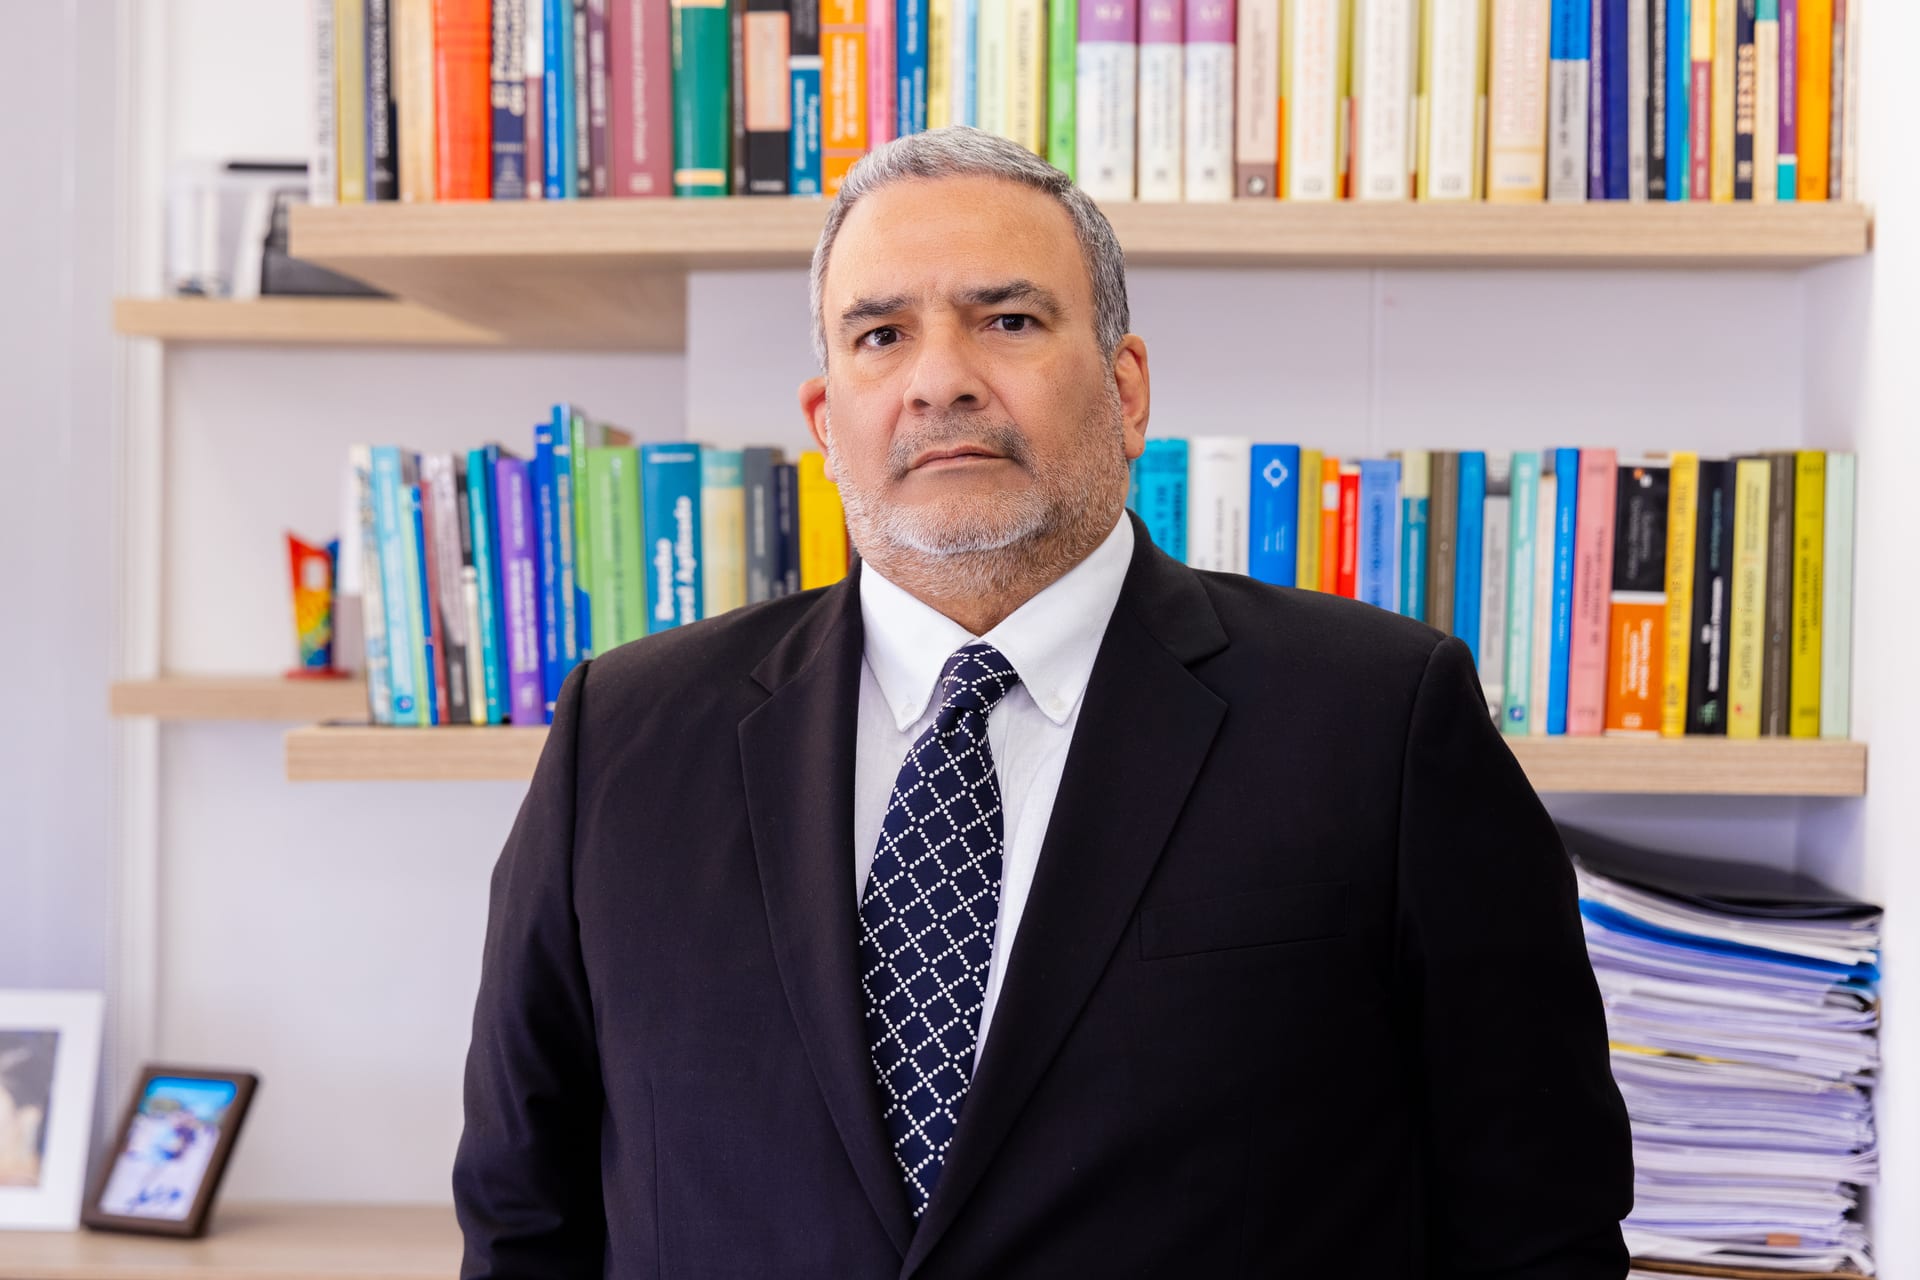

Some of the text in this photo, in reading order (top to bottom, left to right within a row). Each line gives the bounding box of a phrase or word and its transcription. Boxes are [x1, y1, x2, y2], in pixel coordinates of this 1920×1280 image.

[1736, 44, 1754, 135] BIENES
[654, 537, 674, 621] Derecho
[673, 496, 697, 624] oral Aplicado
